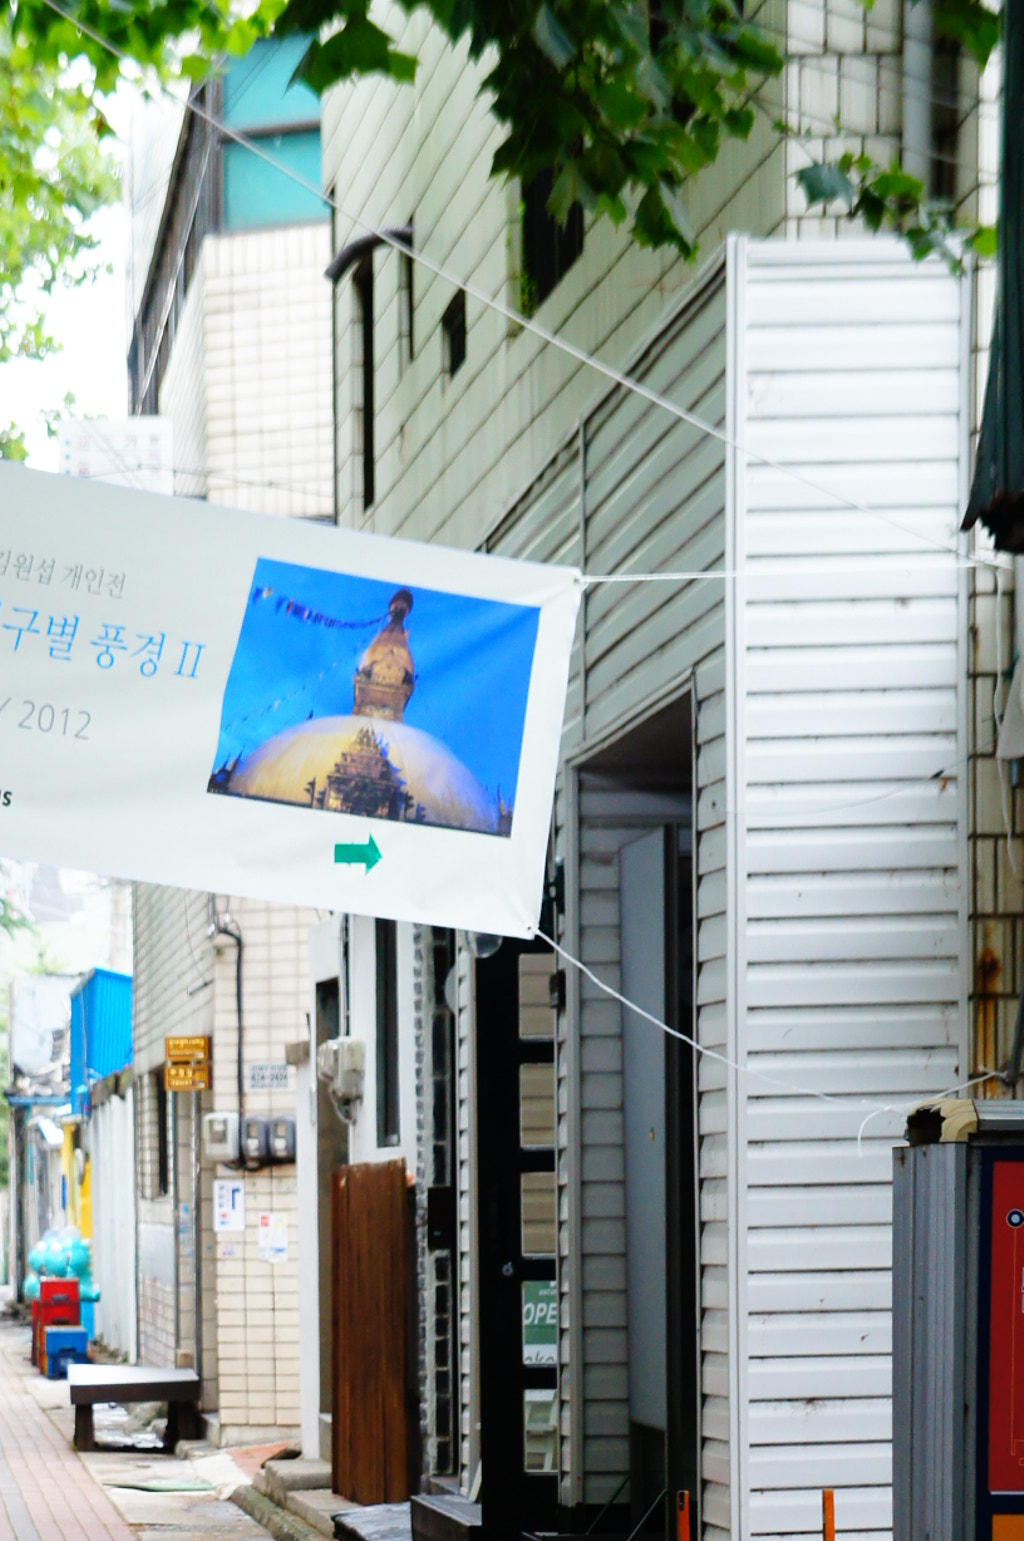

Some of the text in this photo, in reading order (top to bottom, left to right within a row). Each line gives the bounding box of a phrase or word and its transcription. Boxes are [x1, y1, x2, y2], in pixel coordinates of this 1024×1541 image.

[62, 563, 126, 600] 개인전
[89, 622, 166, 678] 풍경
[17, 699, 93, 741] 2012
